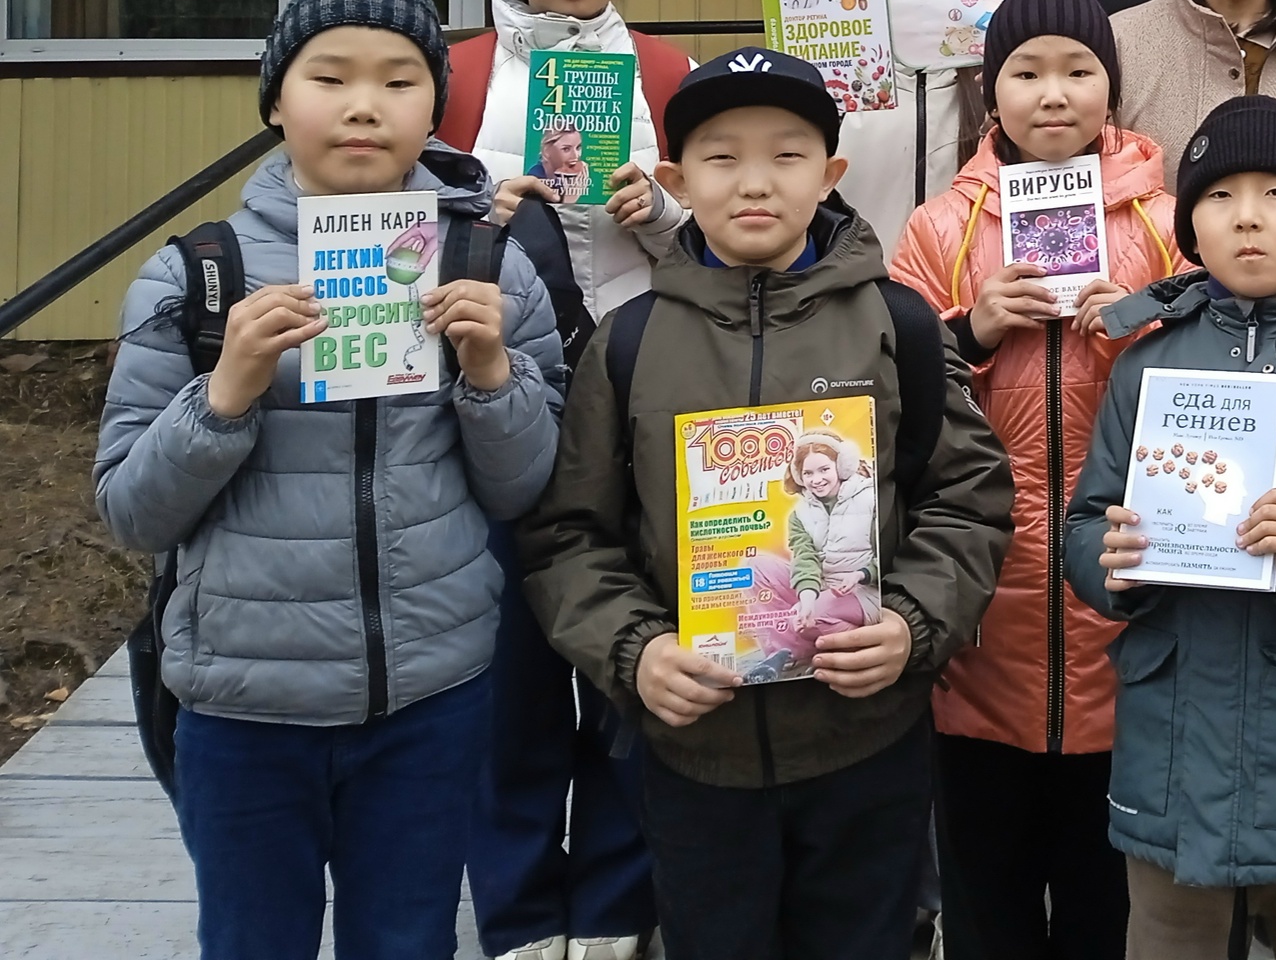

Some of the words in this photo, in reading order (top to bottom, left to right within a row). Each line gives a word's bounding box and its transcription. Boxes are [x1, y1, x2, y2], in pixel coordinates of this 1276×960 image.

[785, 19, 873, 43] ЗДОРОВОЕ
[787, 41, 861, 60] ПИТАНИЕ
[829, 60, 853, 68] ГОРОДЕ
[535, 58, 559, 86] 4
[564, 70, 619, 85] ГРУППЫ
[543, 85, 566, 113] 4
[572, 100, 607, 113] ПУТИ
[612, 101, 621, 114] К
[1009, 170, 1093, 198] ВИРУСЫ
[313, 214, 372, 234] АЛЛЕН
[381, 211, 427, 231] КАРР
[313, 244, 385, 271] ЛЕГКИЙ
[205, 264, 220, 307] SHUNYU
[314, 275, 388, 299] СПОСОБ
[313, 332, 388, 372] ВЕС
[830, 379, 874, 387] OUTVENTURE
[1172, 392, 1216, 411] еда
[1220, 398, 1251, 411] для
[745, 412, 757, 420] 25
[1162, 413, 1256, 433] гениев
[687, 425, 795, 471] 1000
[1157, 508, 1173, 516] КАК
[690, 521, 703, 529] Как
[704, 516, 751, 527] определить
[756, 511, 763, 519] 8
[690, 525, 738, 537] кислотность
[740, 521, 771, 532] почвы?
[691, 545, 714, 554] Травы
[691, 554, 706, 562] для
[706, 549, 744, 560] женского
[747, 548, 755, 556] 14
[1148, 541, 1240, 554] производительность
[1157, 548, 1183, 556] мозга
[691, 560, 727, 570] здоровья
[1180, 562, 1212, 570] память
[761, 591, 771, 600] 23
[739, 609, 797, 621] Международный
[739, 622, 756, 630] день
